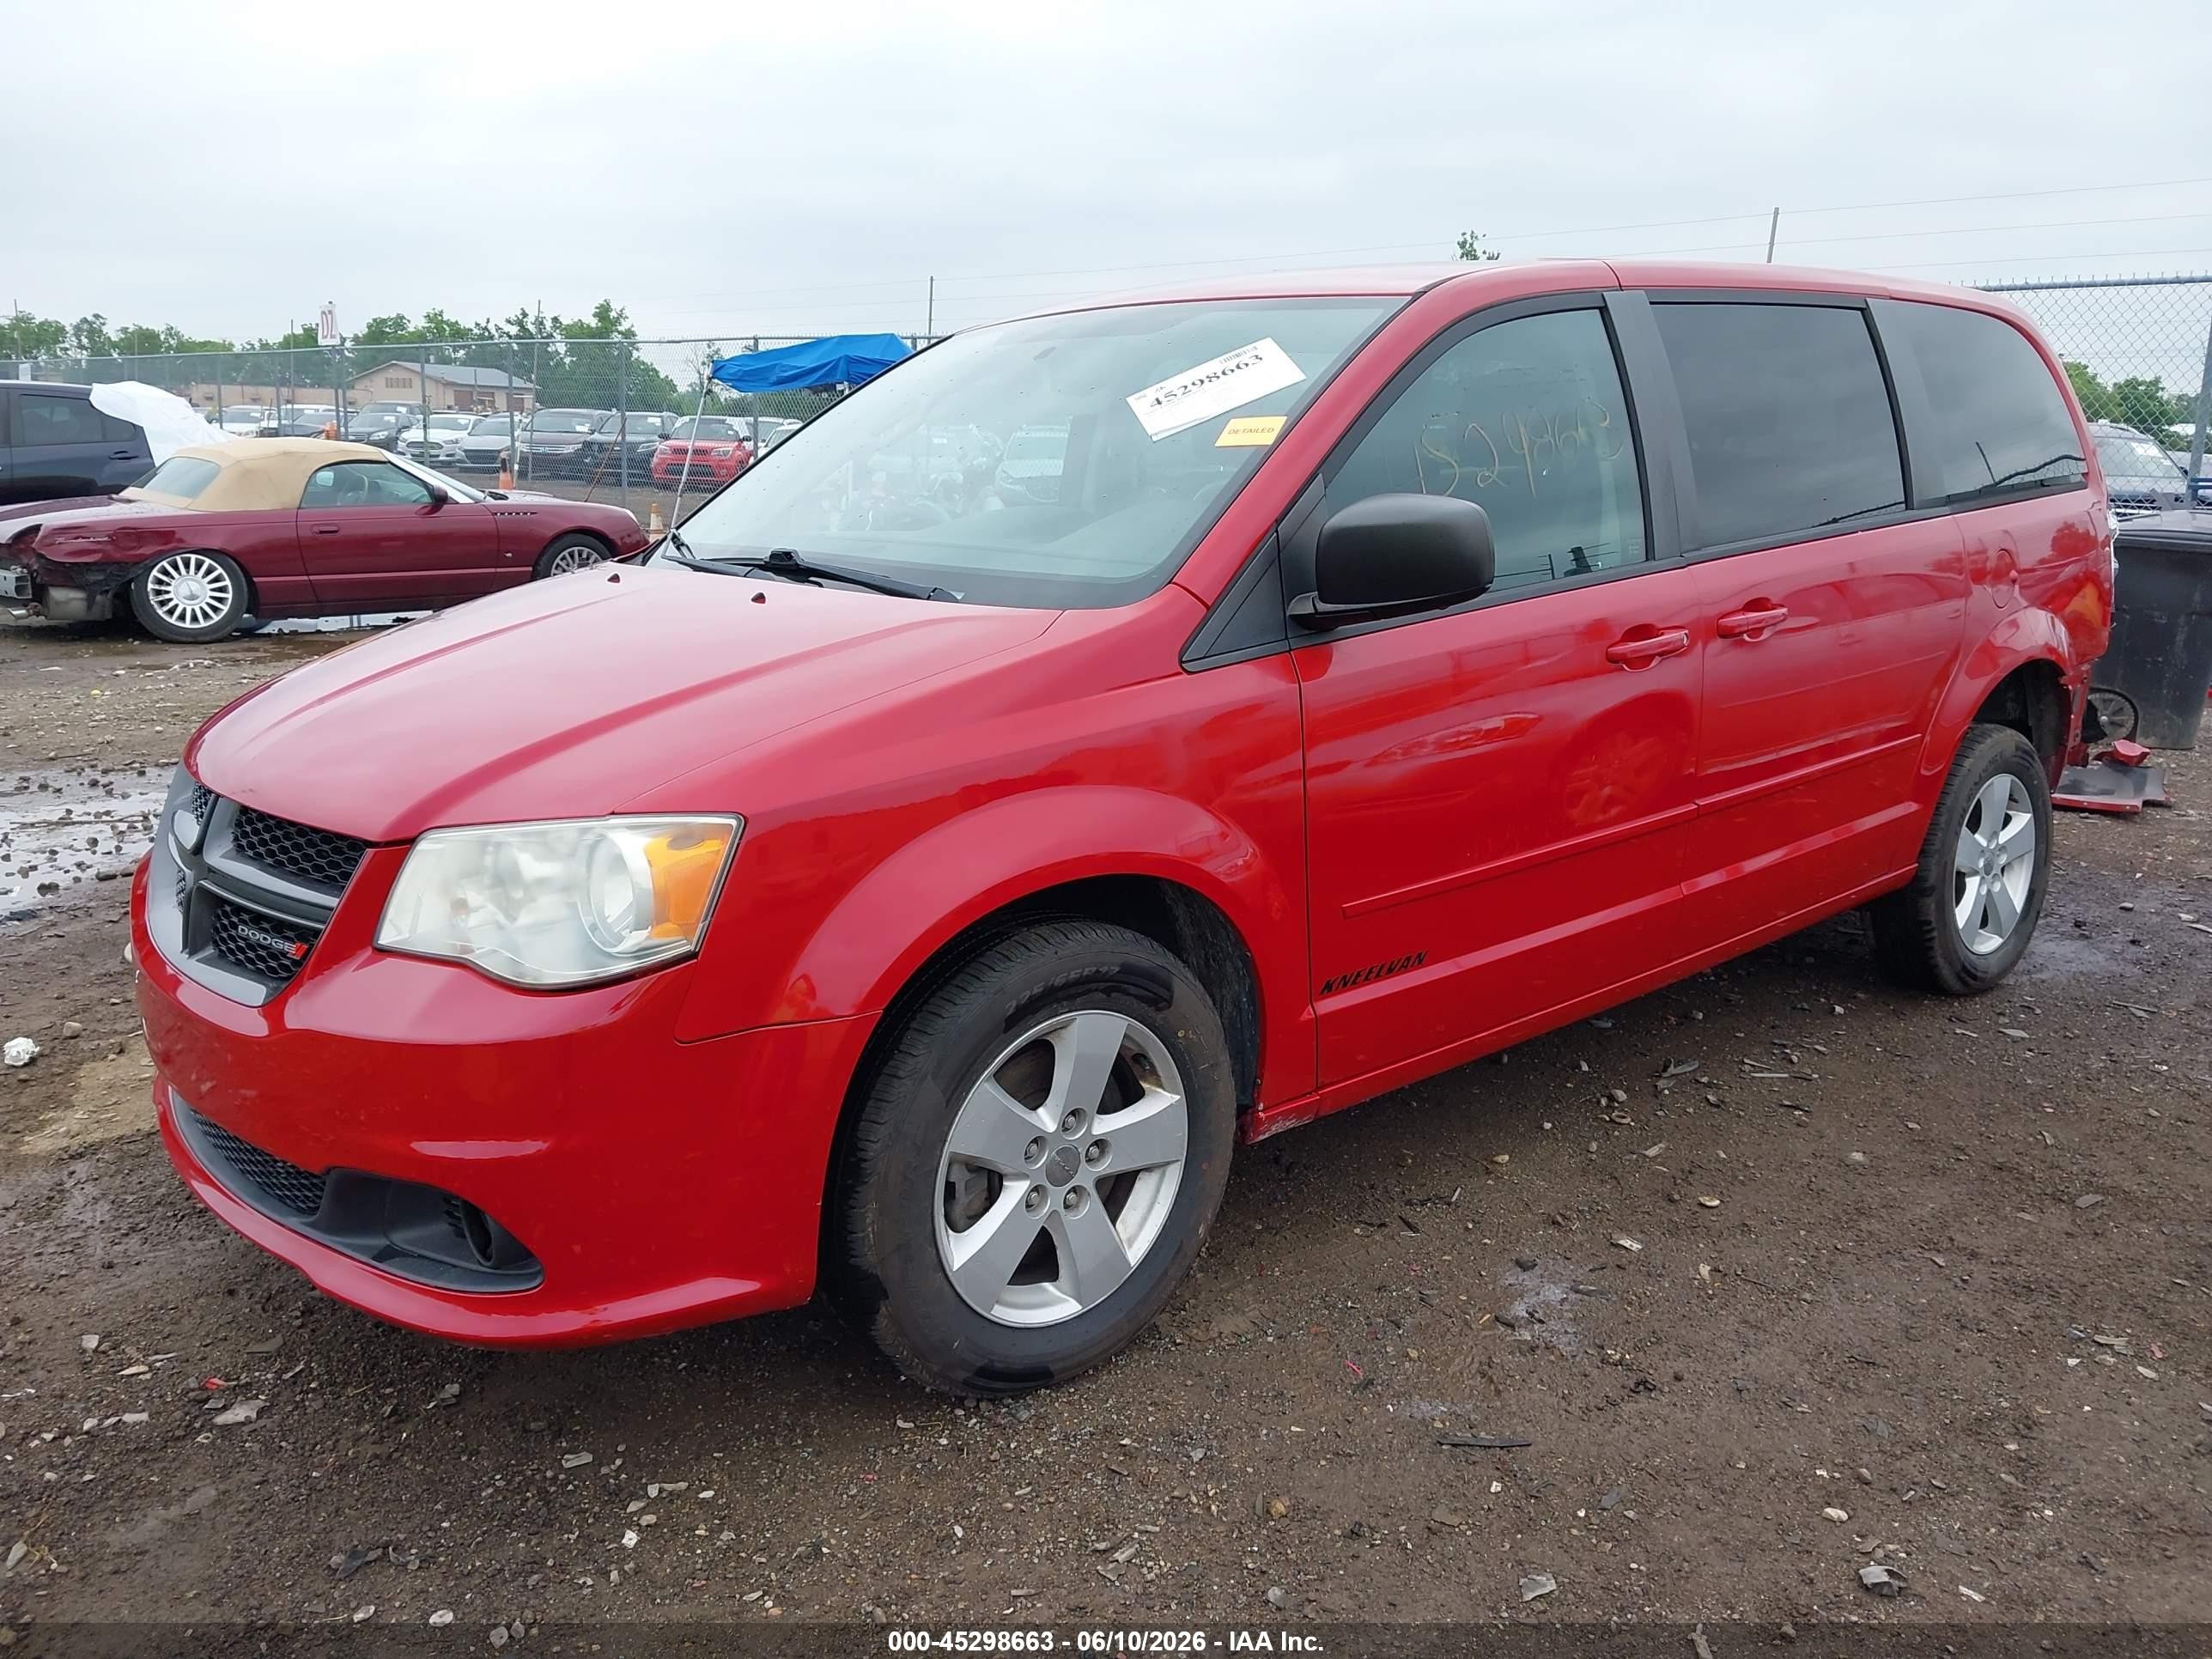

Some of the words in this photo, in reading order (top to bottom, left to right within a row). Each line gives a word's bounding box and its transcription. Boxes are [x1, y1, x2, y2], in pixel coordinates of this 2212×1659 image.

[1149, 353, 1265, 409] 45298663
[1226, 426, 1276, 436] DETAILED
[237, 924, 297, 955] DODGE
